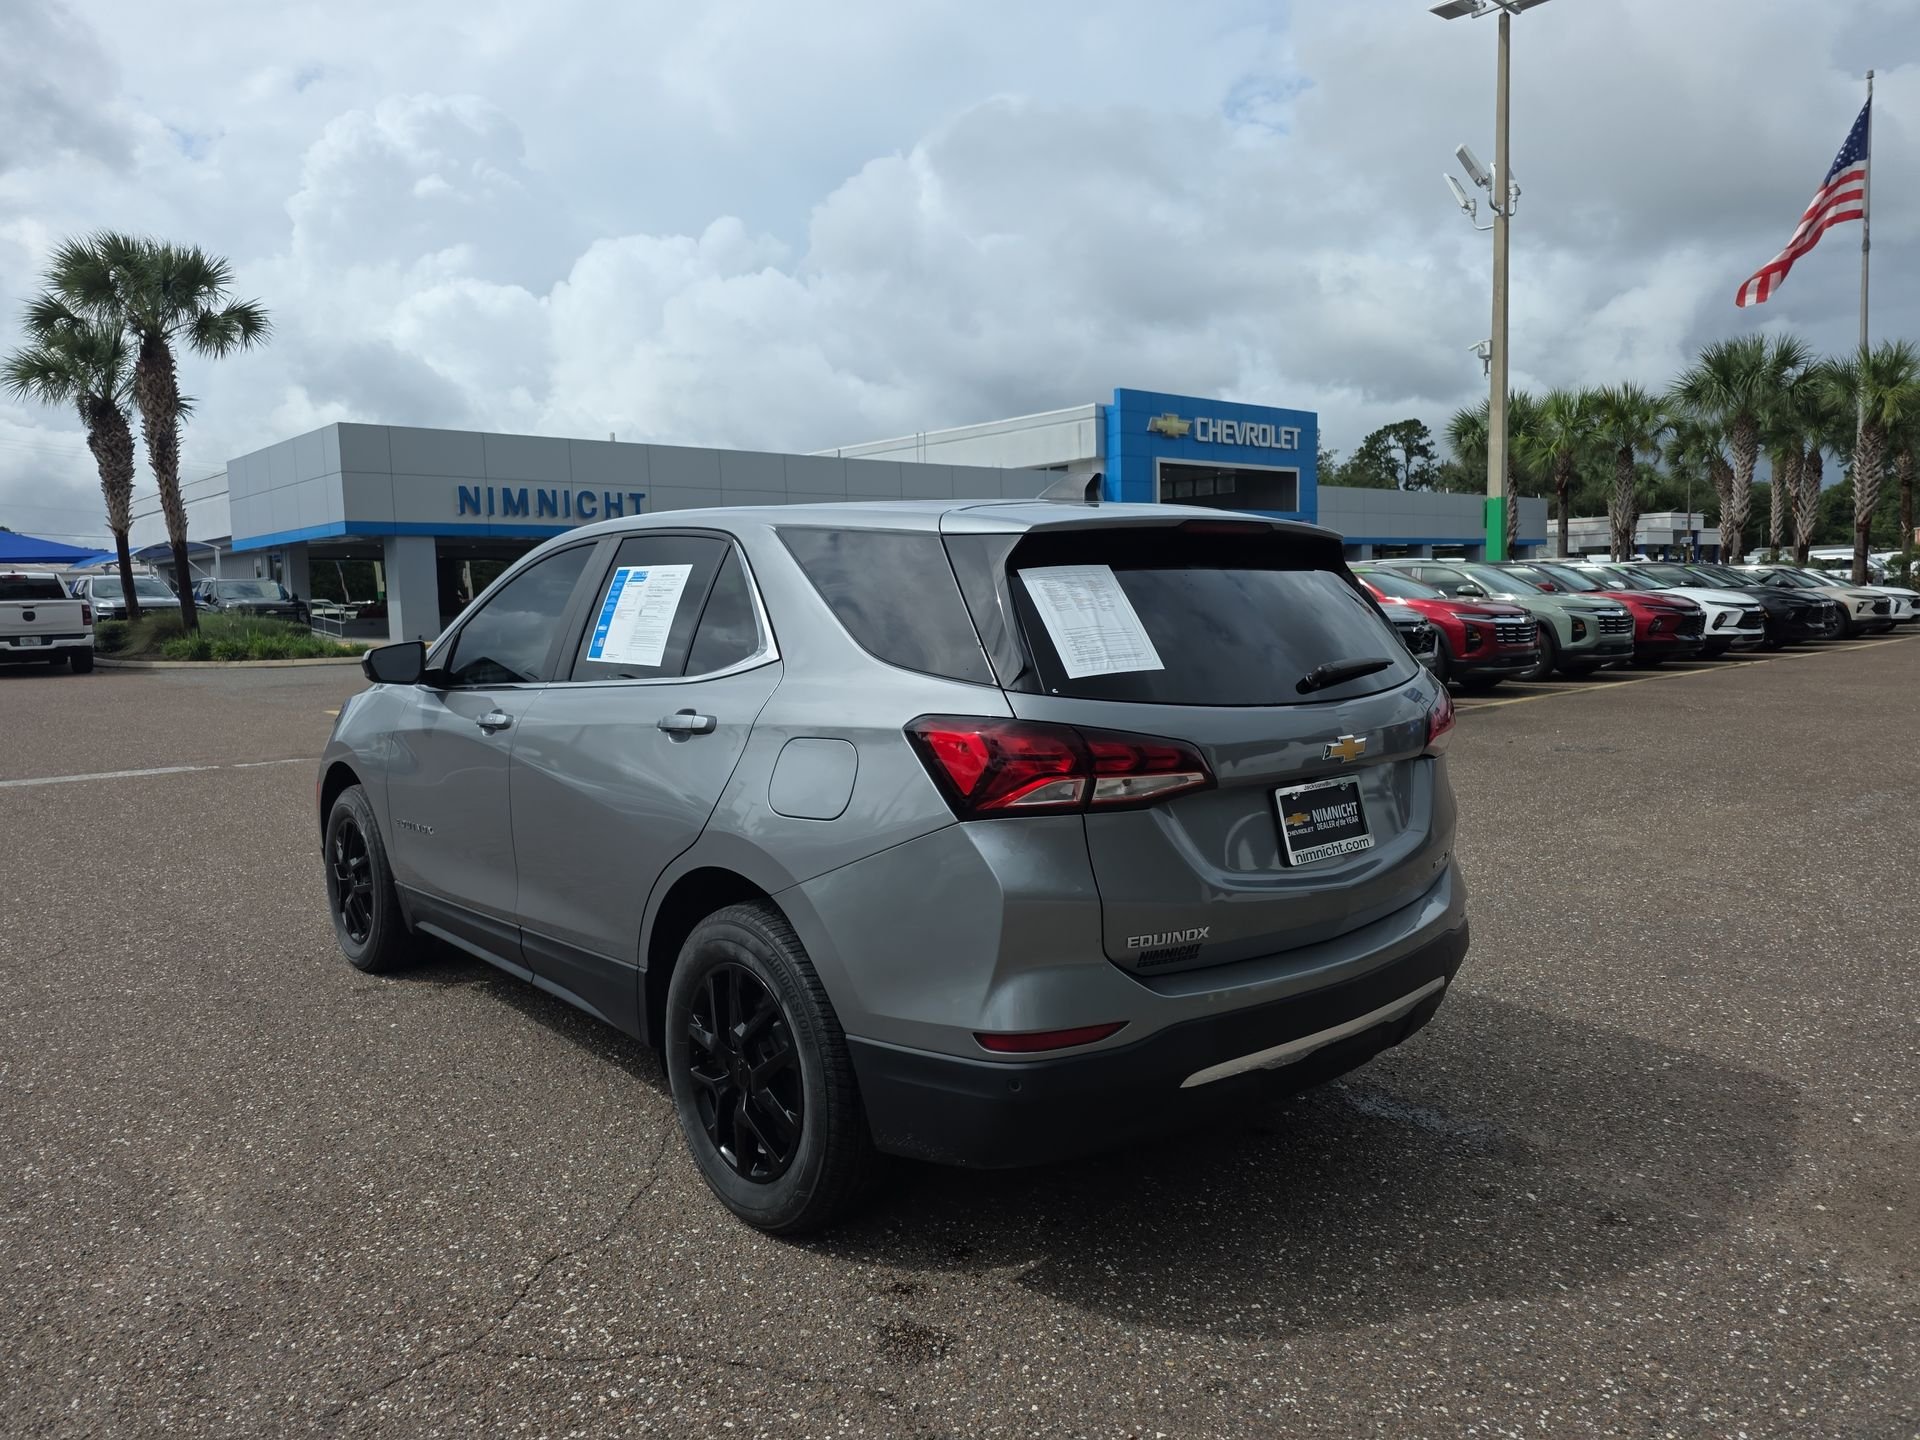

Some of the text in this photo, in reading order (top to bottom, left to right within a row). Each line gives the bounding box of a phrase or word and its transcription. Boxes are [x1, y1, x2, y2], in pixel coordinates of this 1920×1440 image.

[1195, 416, 1301, 450] CHEVROLET
[457, 485, 646, 519] NIMNICHT
[1312, 802, 1357, 823] NIMNICHT
[1316, 819, 1336, 831] DEALER
[1345, 815, 1359, 825] YEAR
[1295, 838, 1369, 863] nimnicht.com
[1127, 926, 1210, 949] EQUINOX
